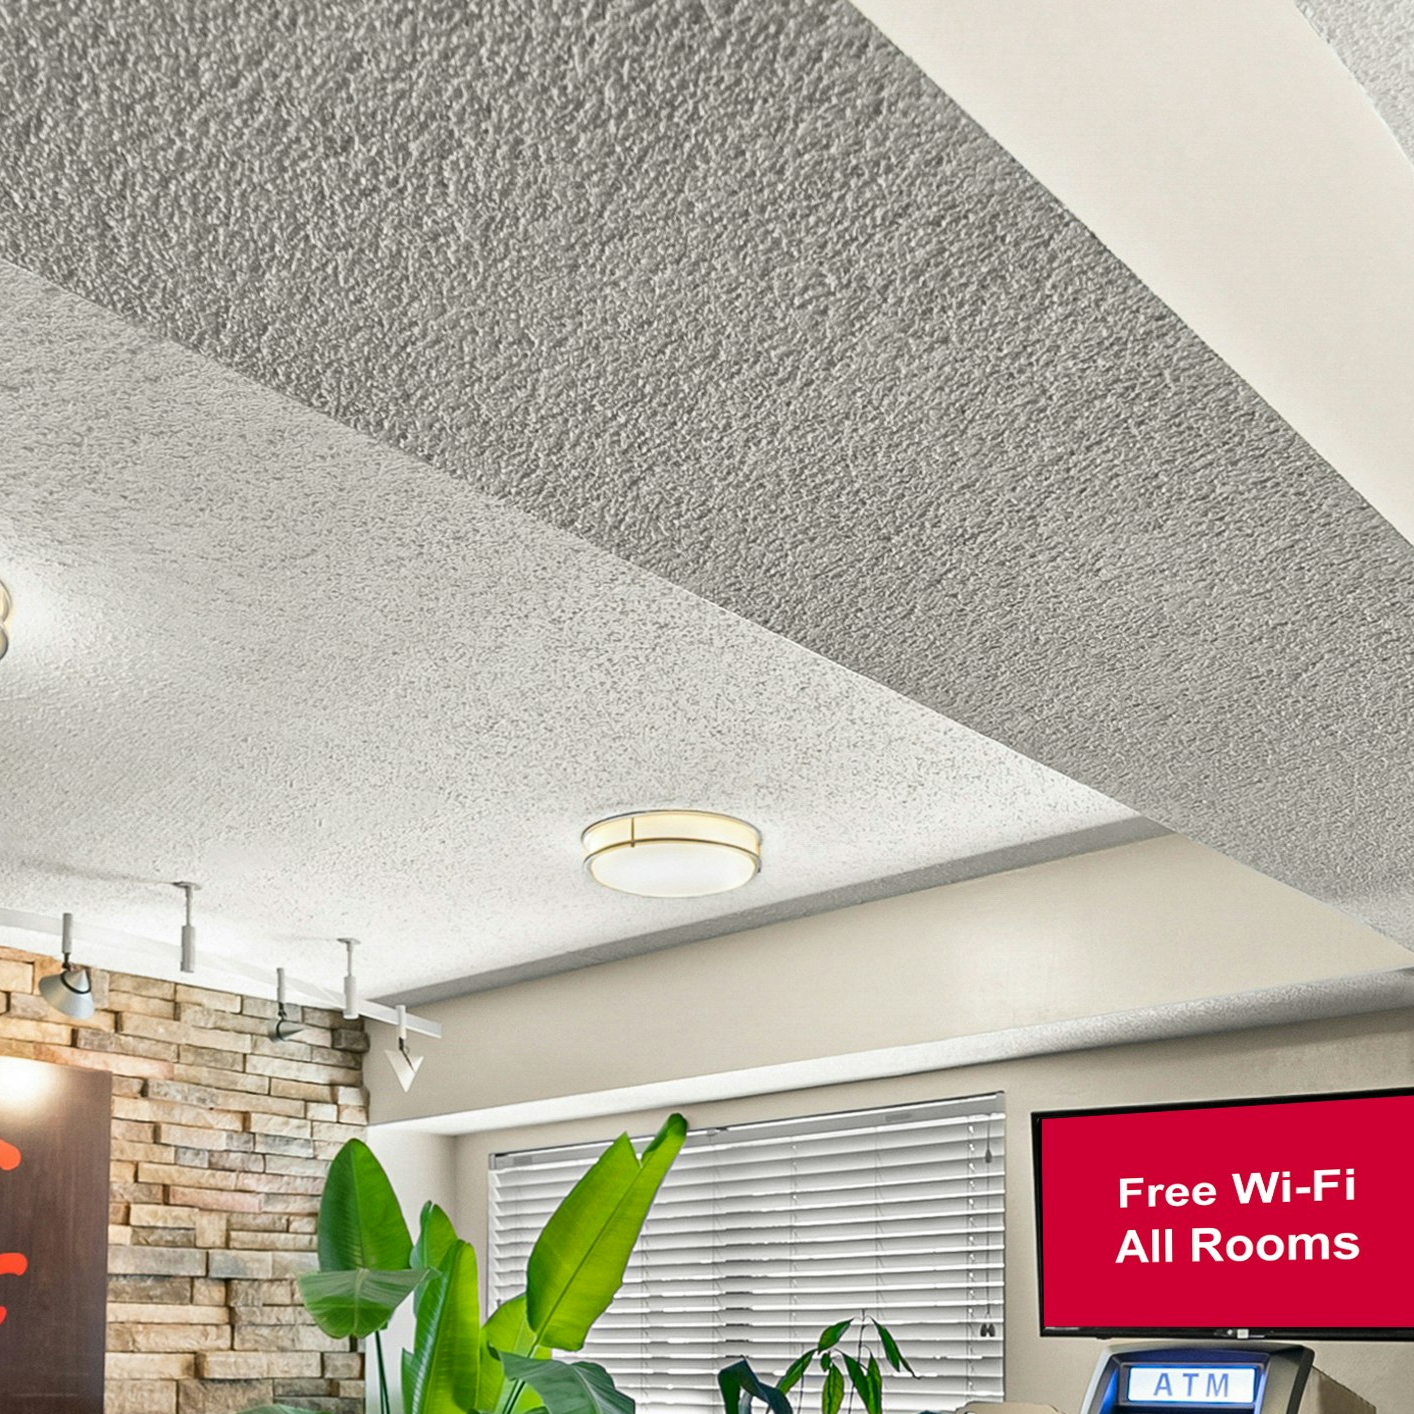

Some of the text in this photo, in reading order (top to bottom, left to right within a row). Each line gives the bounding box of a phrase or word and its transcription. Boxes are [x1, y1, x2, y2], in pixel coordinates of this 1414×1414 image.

[1119, 1168, 1355, 1208] Free Wi-Fi
[1115, 1227, 1360, 1263] All Rooms
[1153, 1372, 1229, 1397] ATM
